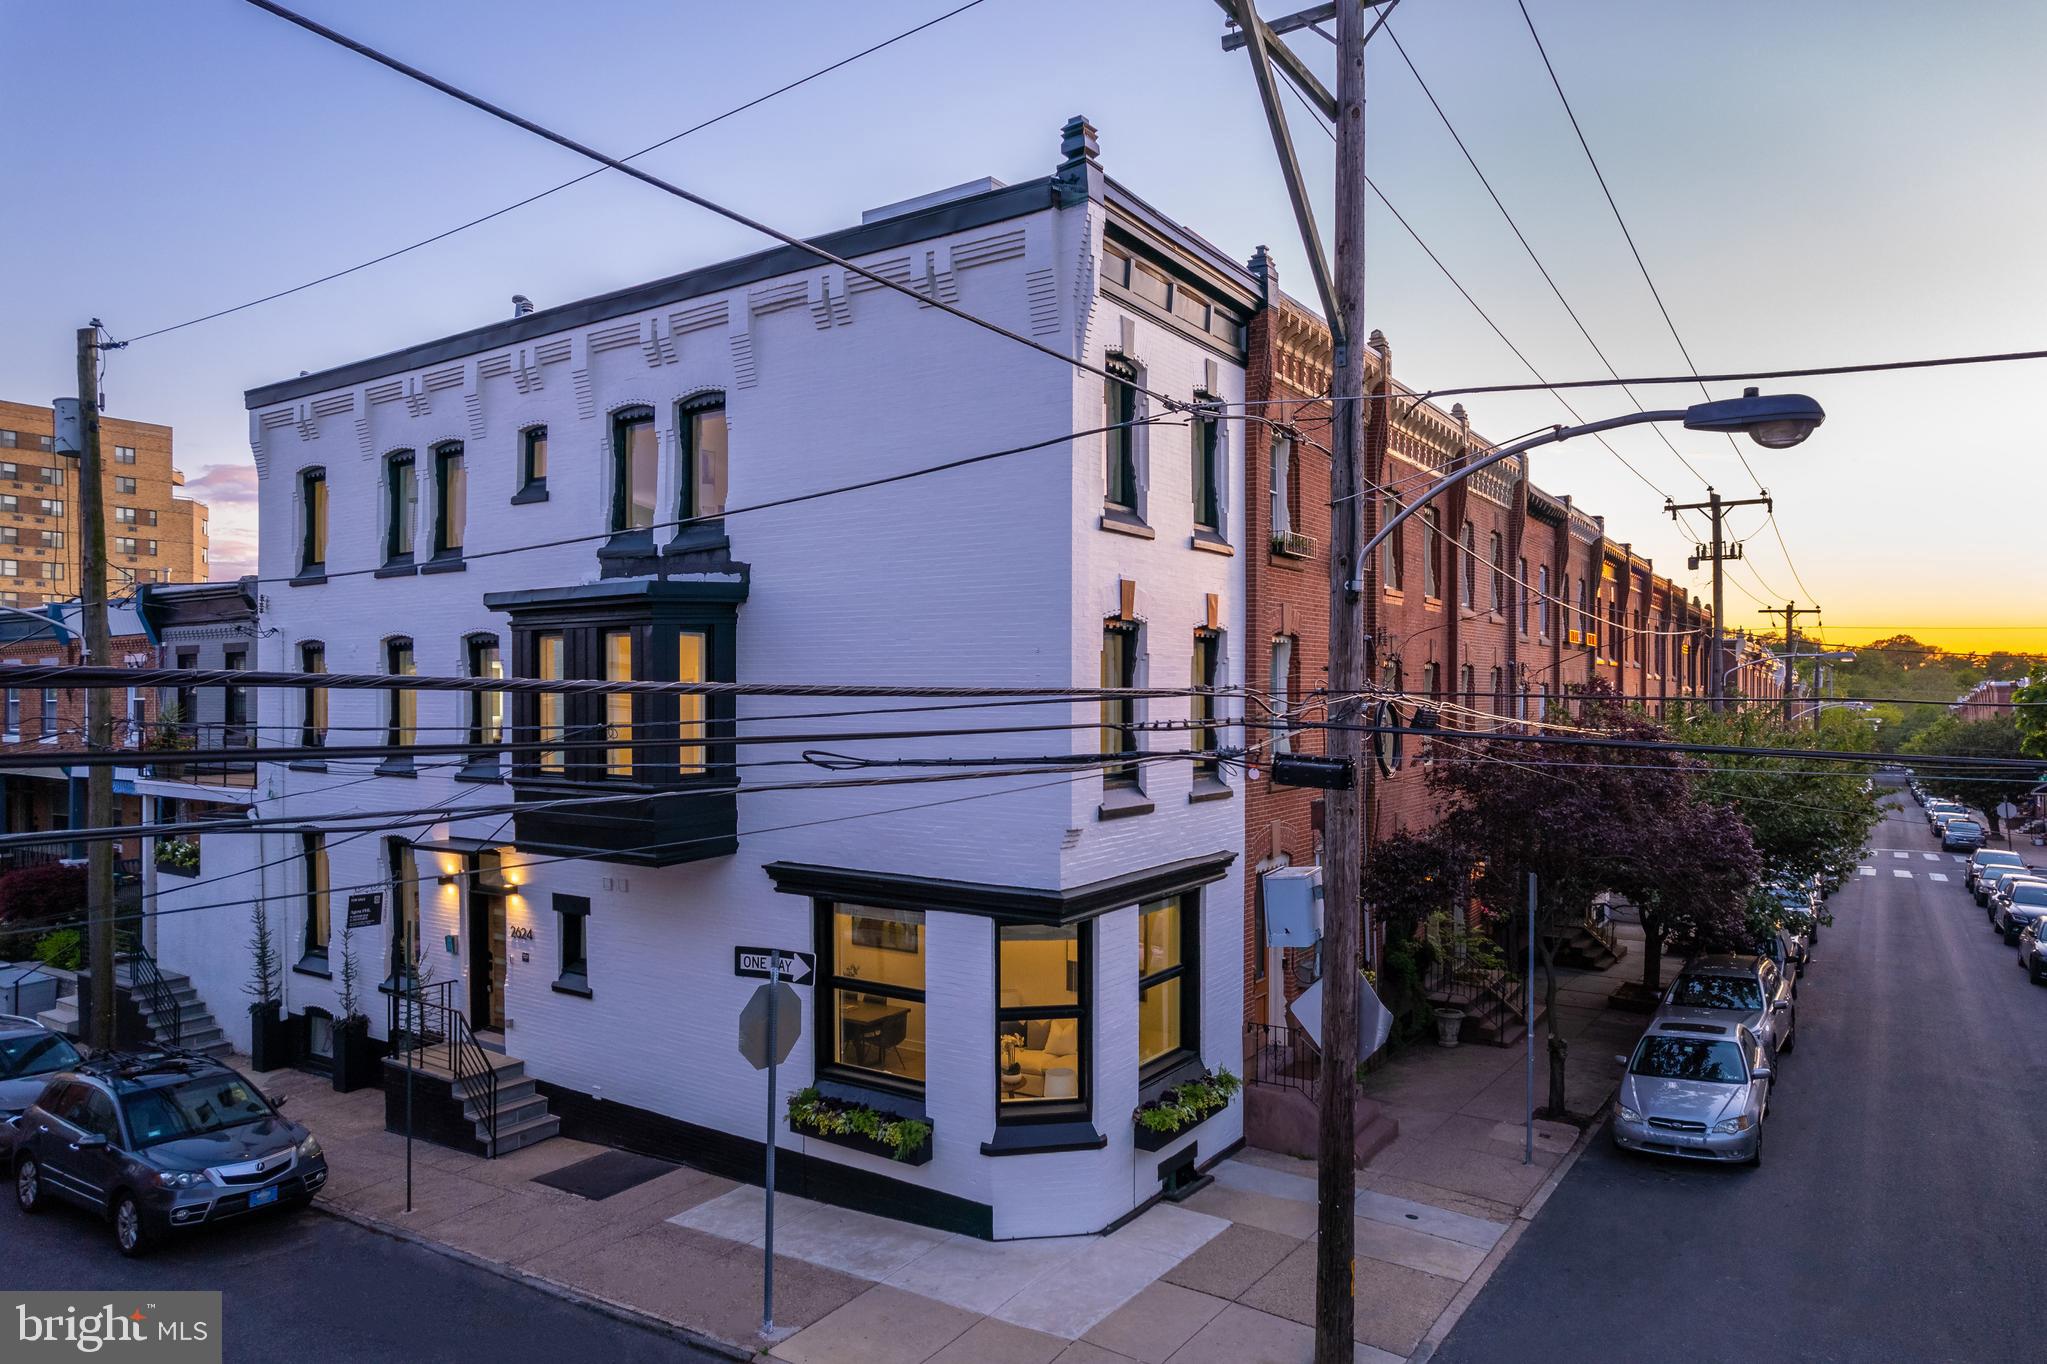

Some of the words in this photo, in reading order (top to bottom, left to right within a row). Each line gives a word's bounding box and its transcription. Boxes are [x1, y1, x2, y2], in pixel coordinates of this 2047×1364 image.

[510, 925, 533, 940] 2624
[743, 955, 767, 970] ONE
[778, 959, 792, 973] AY
